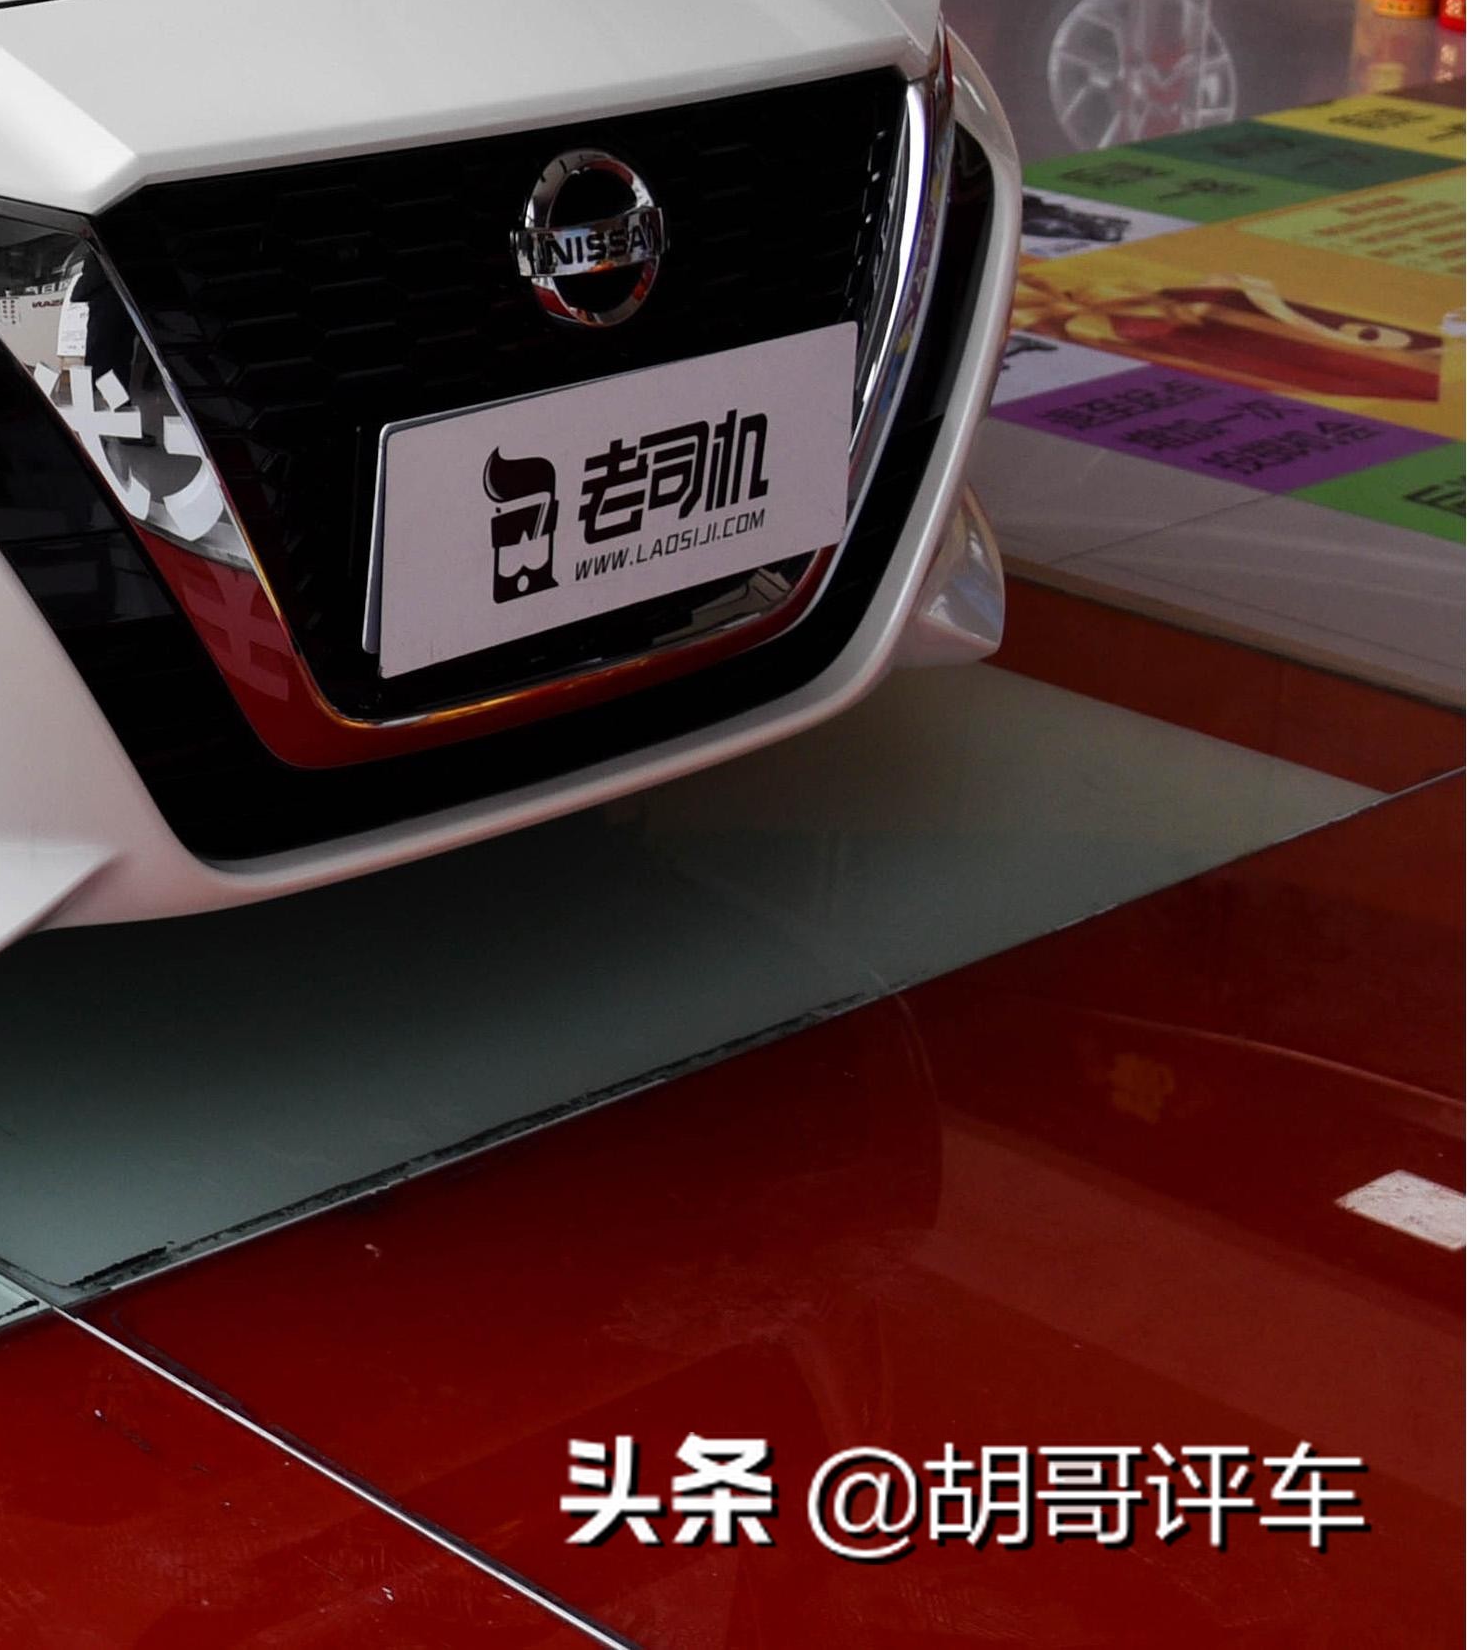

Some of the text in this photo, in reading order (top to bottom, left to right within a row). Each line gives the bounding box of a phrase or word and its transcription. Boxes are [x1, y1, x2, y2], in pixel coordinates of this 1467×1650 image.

[577, 409, 769, 544] 老司机
[574, 508, 766, 582] WWW.LAOSIJI.COM
